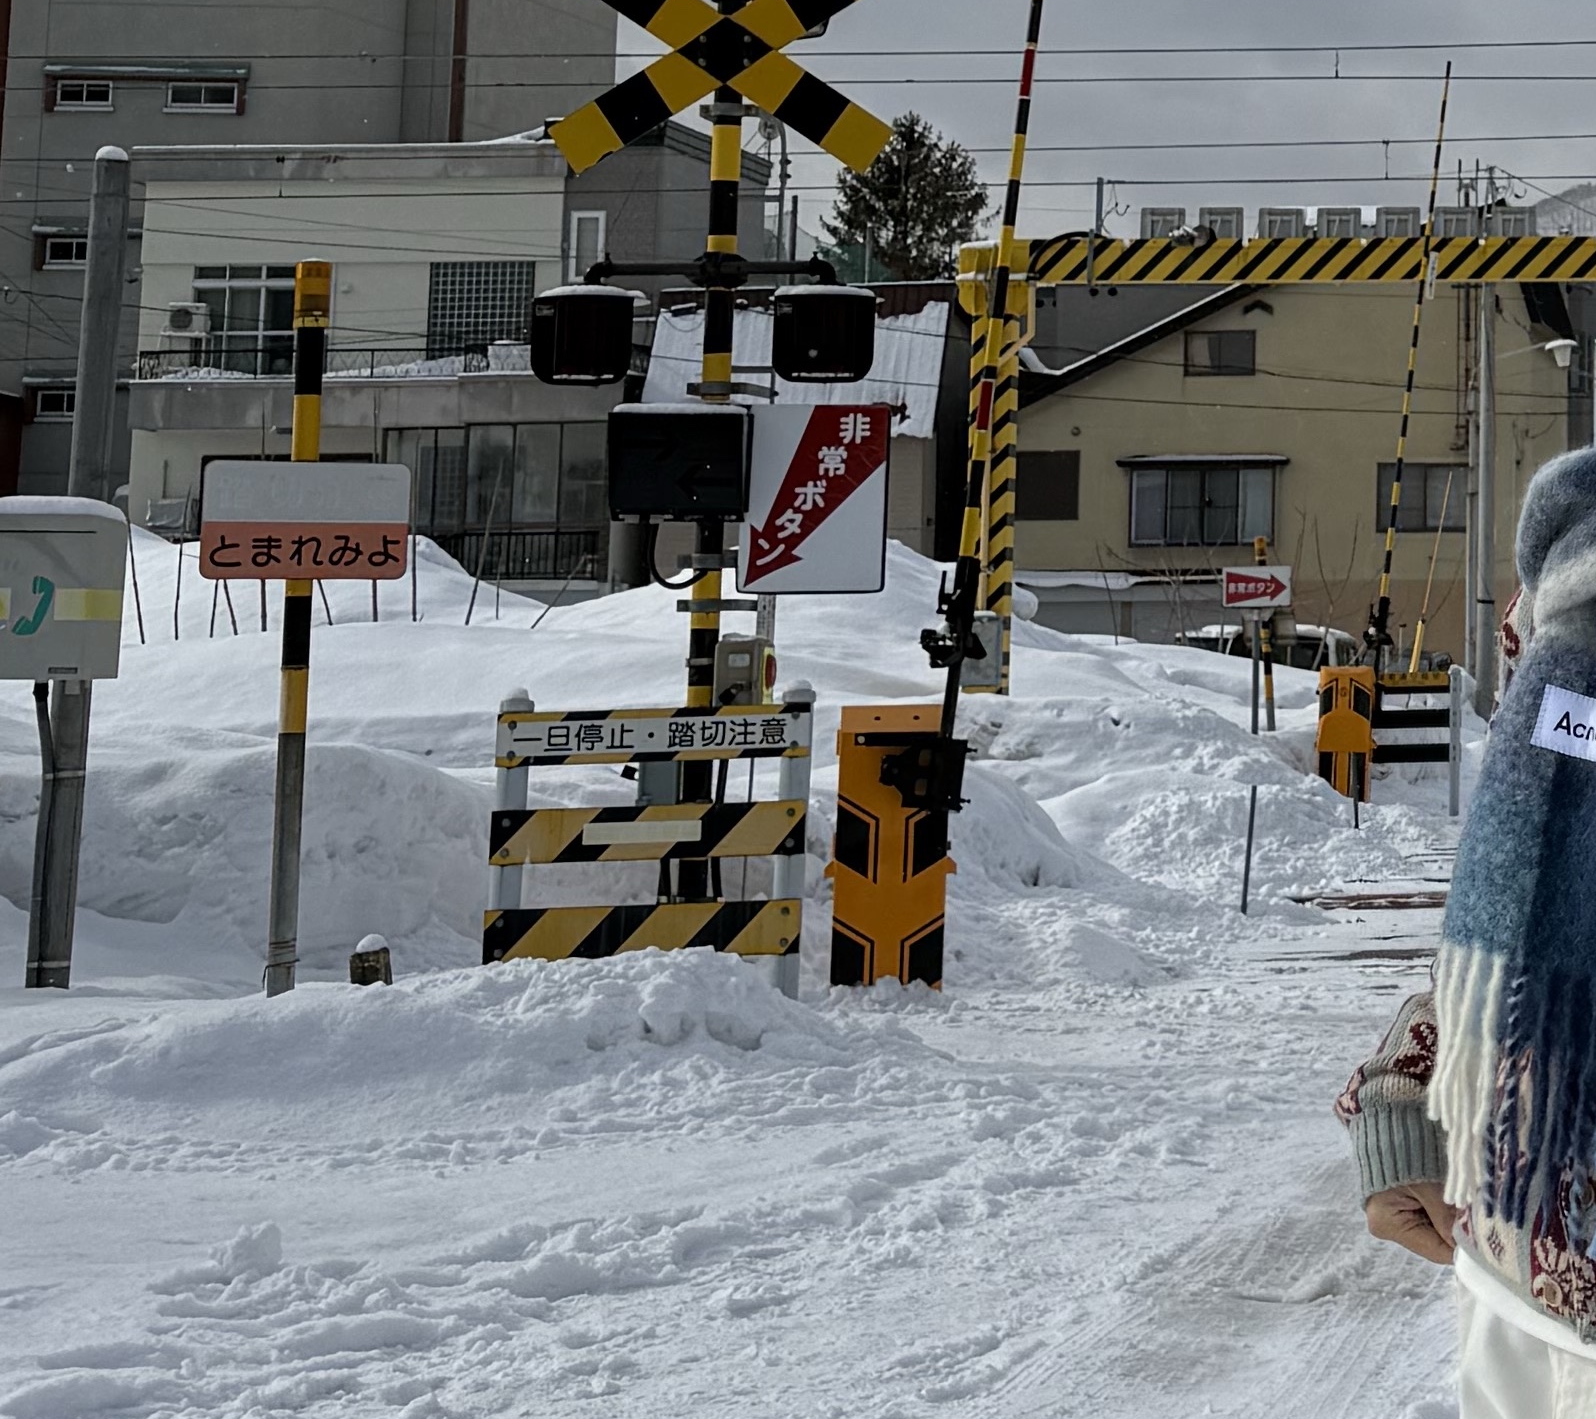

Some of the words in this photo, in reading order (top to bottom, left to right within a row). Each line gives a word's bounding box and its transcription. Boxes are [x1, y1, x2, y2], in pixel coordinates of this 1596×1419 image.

[756, 413, 871, 566] 非常ボタン
[209, 535, 401, 568] とまれみよ
[513, 717, 789, 753] 一旦停止・踏切注意
